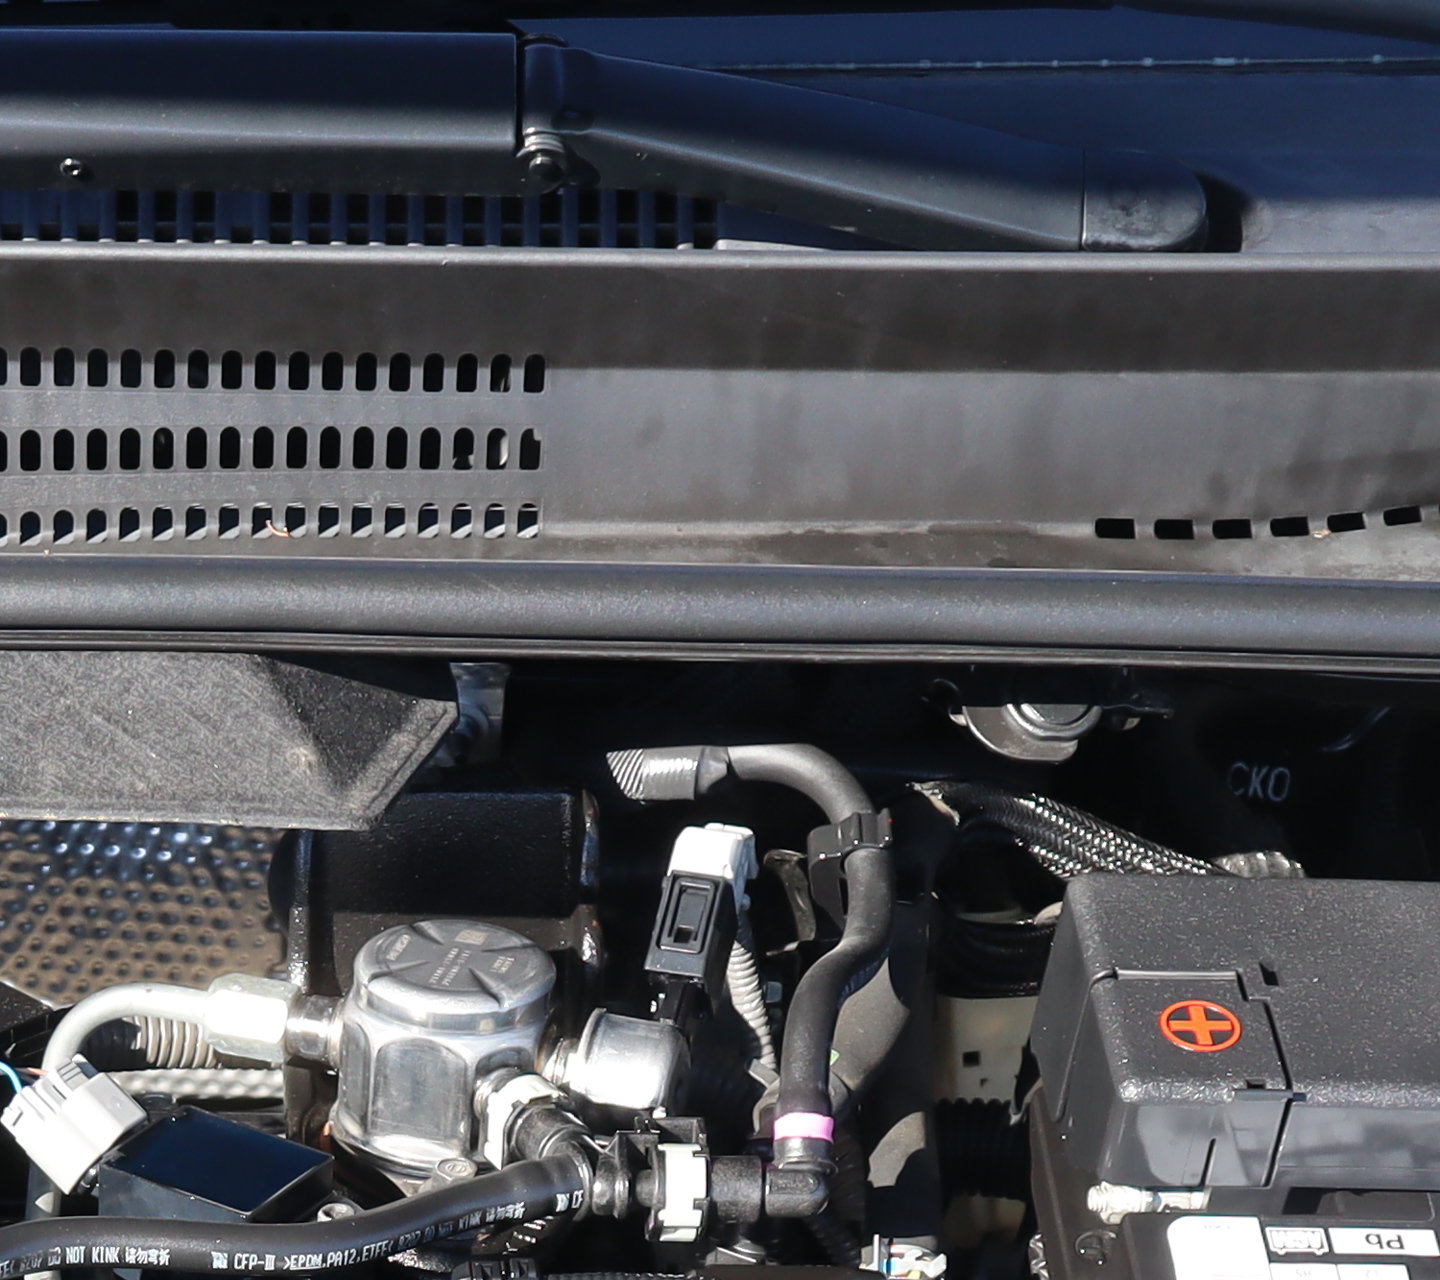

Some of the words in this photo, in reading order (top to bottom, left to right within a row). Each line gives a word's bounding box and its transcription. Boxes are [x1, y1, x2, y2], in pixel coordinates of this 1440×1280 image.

[1364, 1232, 1405, 1250] Pb
[66, 1246, 86, 1264] NOT
[91, 1247, 120, 1265] KINK
